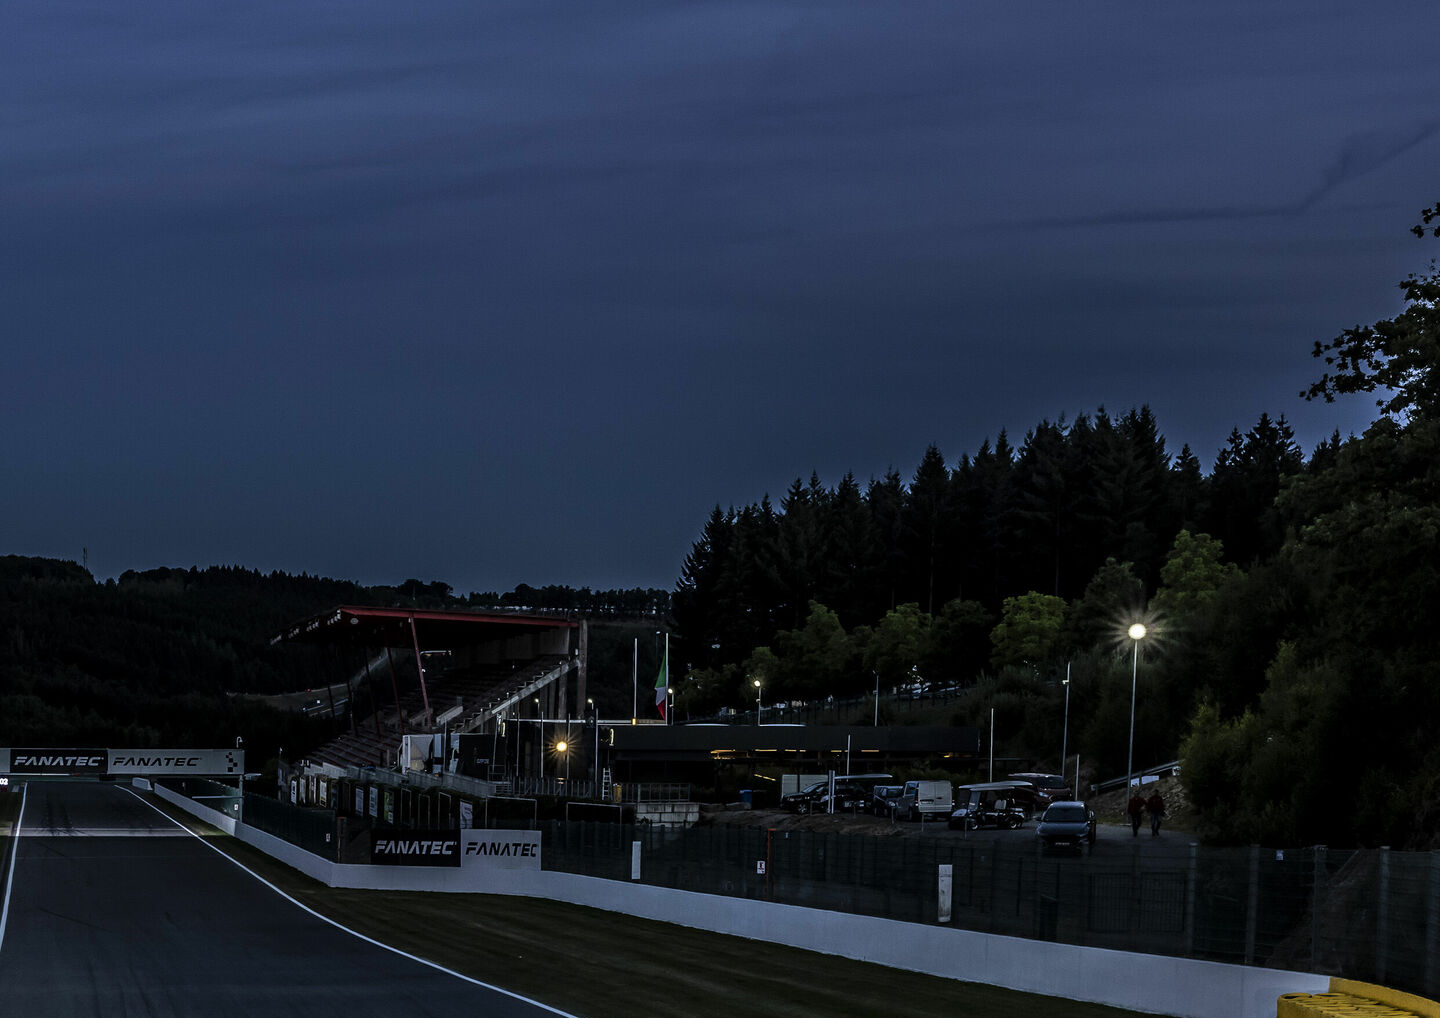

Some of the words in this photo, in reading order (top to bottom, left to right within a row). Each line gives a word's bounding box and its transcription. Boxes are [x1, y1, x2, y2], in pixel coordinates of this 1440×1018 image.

[14, 756, 102, 767] FANATEC
[113, 757, 203, 767] FANATEC
[375, 840, 456, 855] FANATEC
[465, 842, 538, 857] FANATEC
